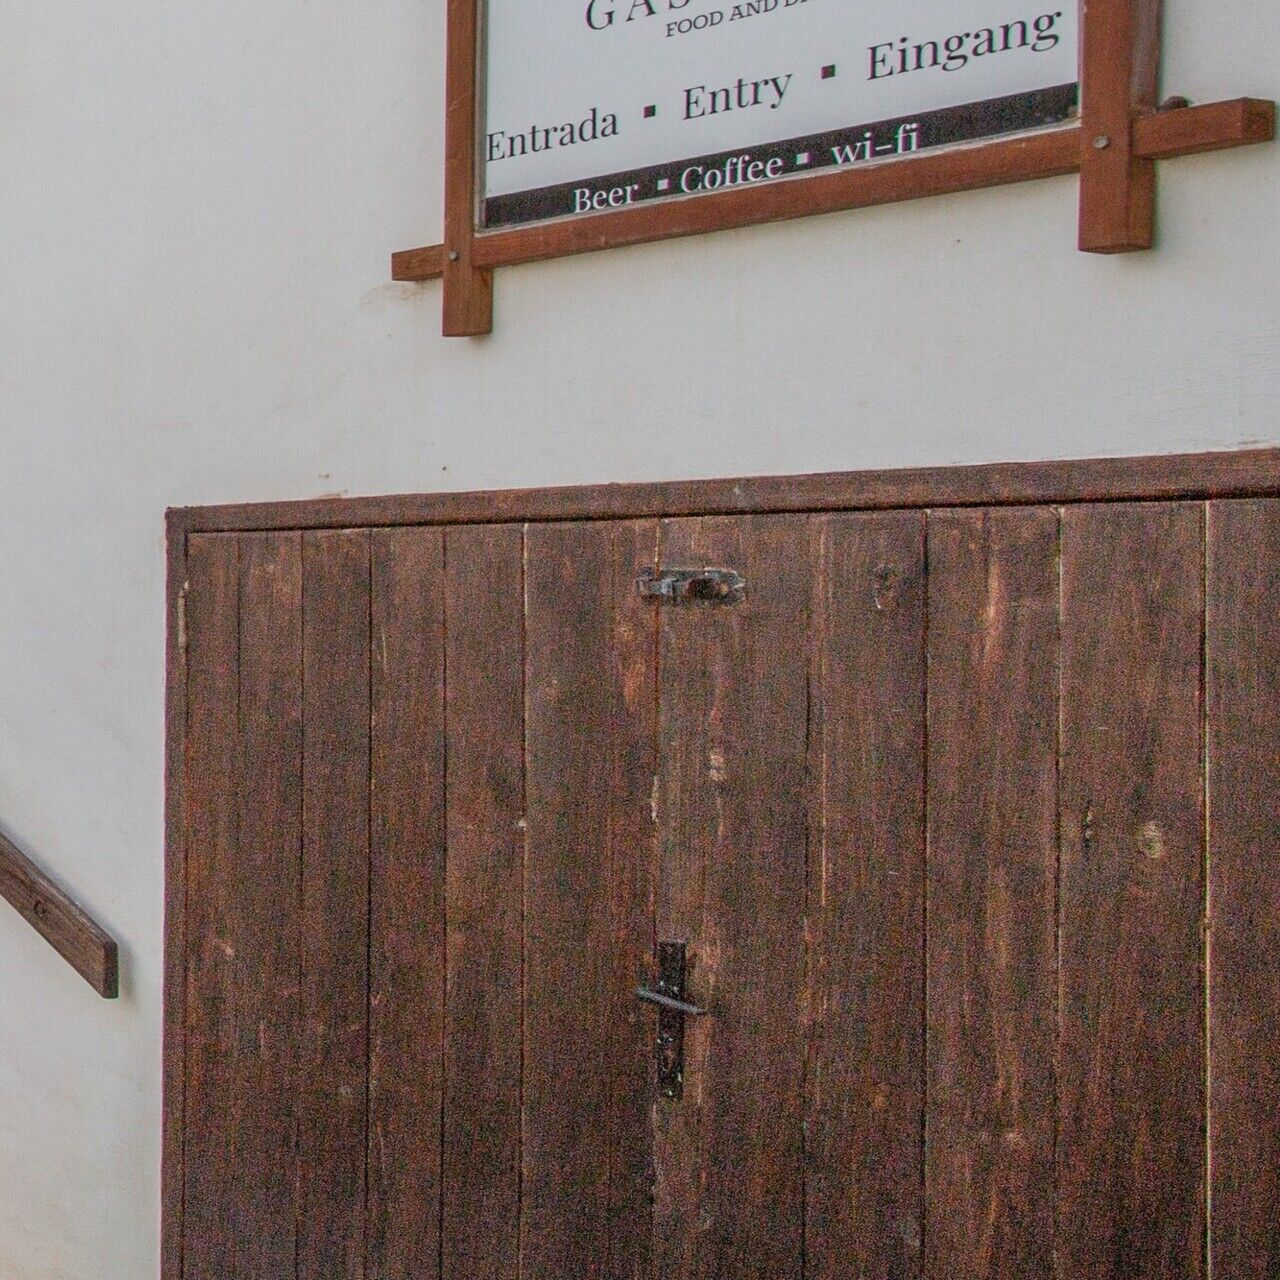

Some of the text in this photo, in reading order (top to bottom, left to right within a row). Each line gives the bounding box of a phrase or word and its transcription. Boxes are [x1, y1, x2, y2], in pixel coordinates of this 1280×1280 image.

[665, 10, 724, 38] FOOD
[485, 10, 1063, 162] Entrada Entry Eingang
[572, 122, 921, 215] Beer Coffee wi-fi
